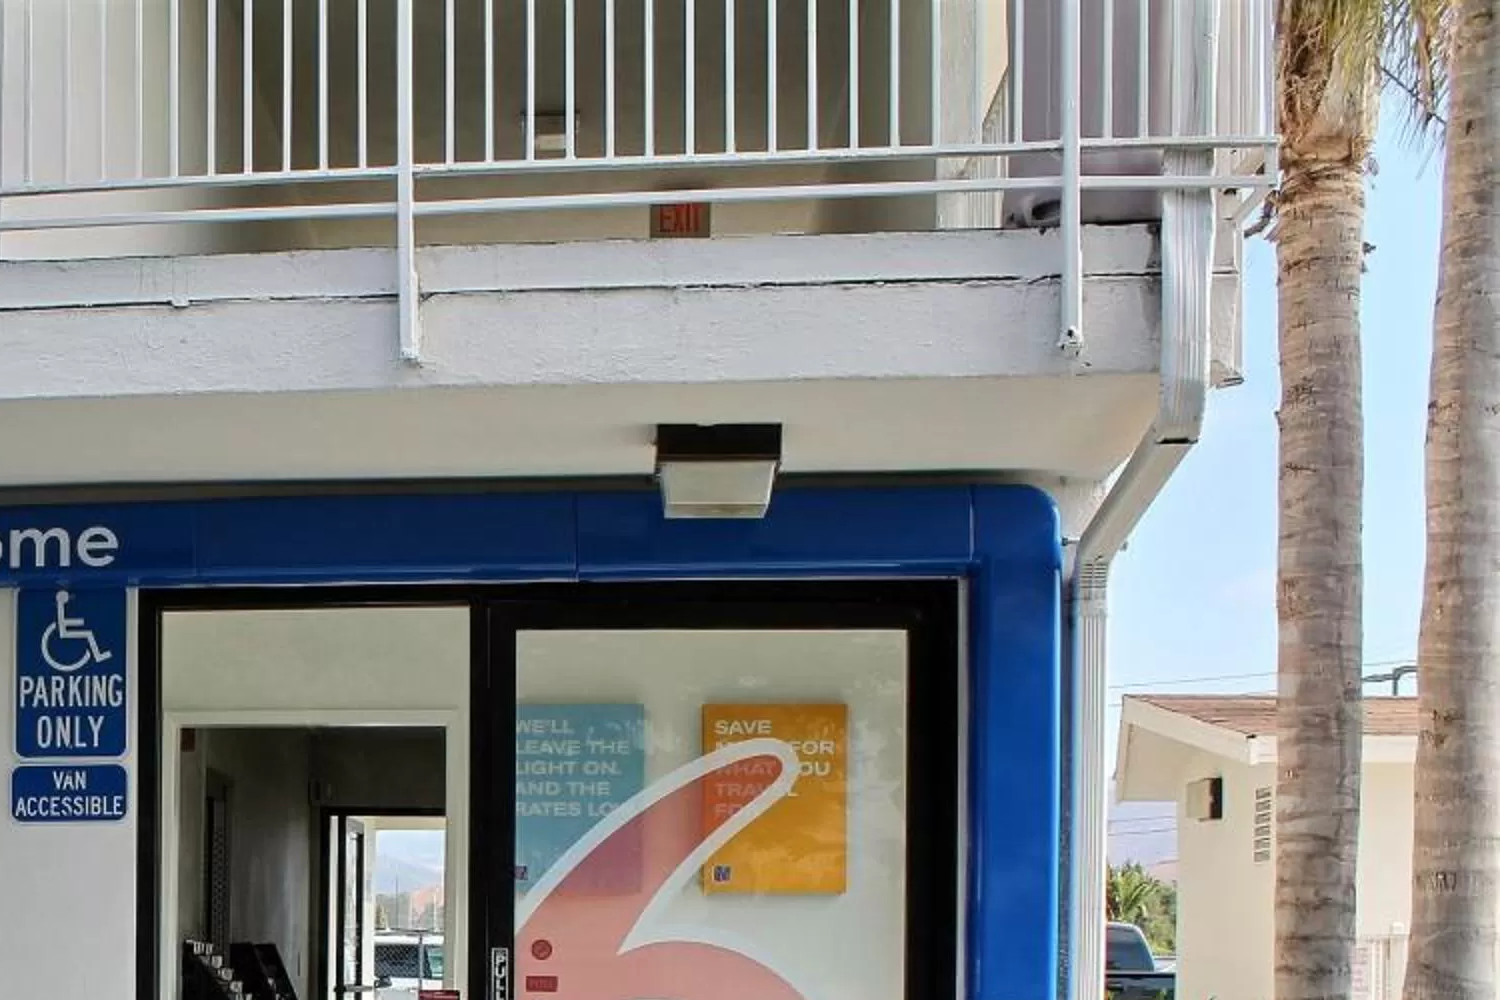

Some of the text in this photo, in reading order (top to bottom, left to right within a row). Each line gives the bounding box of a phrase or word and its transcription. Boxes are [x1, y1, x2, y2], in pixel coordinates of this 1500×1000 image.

[19, 674, 124, 708] PARKING
[36, 715, 105, 749] ONLY
[715, 719, 772, 735] SAVE
[515, 739, 630, 755] LEAVE THE
[515, 760, 579, 775] LIGHT
[798, 760, 832, 777] OU
[53, 771, 87, 790] VAN
[565, 780, 611, 796] THE
[15, 796, 124, 817] ACCESSIBLE
